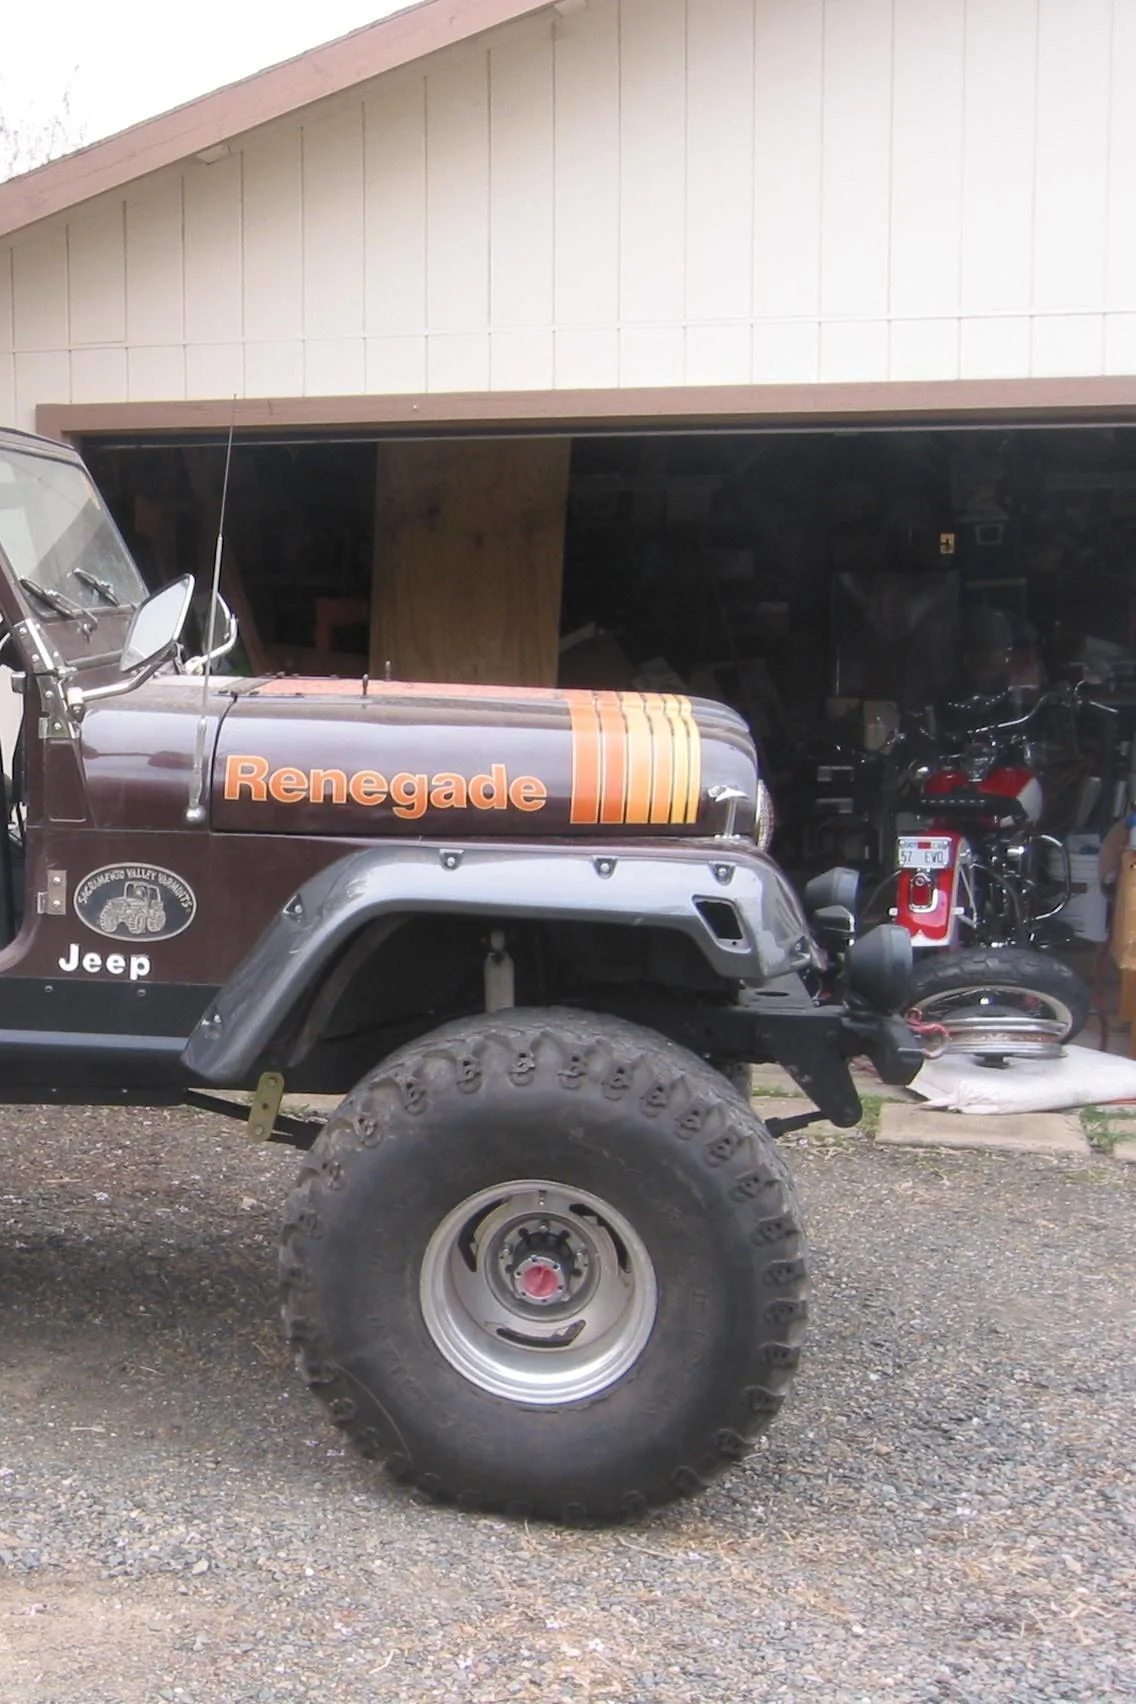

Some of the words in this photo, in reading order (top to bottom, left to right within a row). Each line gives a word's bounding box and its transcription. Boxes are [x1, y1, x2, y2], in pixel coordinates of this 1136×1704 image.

[224, 755, 548, 820] Renegade
[126, 868, 157, 881] VALLEY
[158, 873, 193, 908] VARMINTS
[59, 943, 151, 981] Jeep
